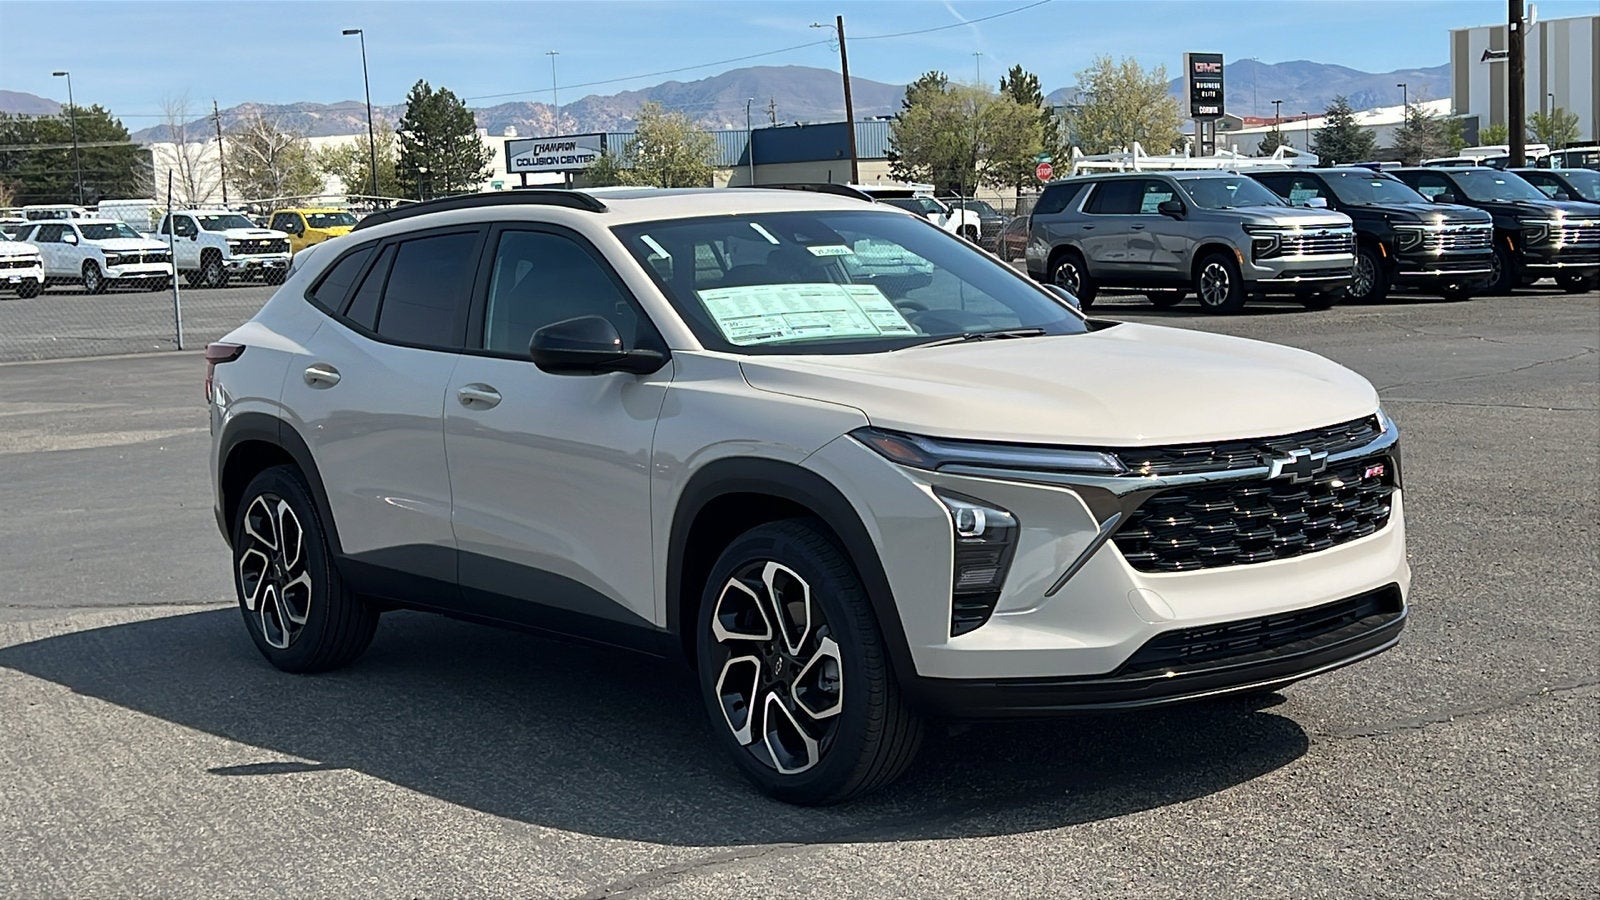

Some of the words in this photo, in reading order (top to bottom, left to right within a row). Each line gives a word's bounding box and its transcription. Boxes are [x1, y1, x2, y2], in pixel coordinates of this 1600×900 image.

[1194, 62, 1221, 73] GMC
[533, 142, 576, 156] CHAMPION
[516, 157, 559, 166] COLLISION
[560, 154, 595, 164] CENTER
[1037, 167, 1052, 176] STOP
[1364, 465, 1384, 479] RS
